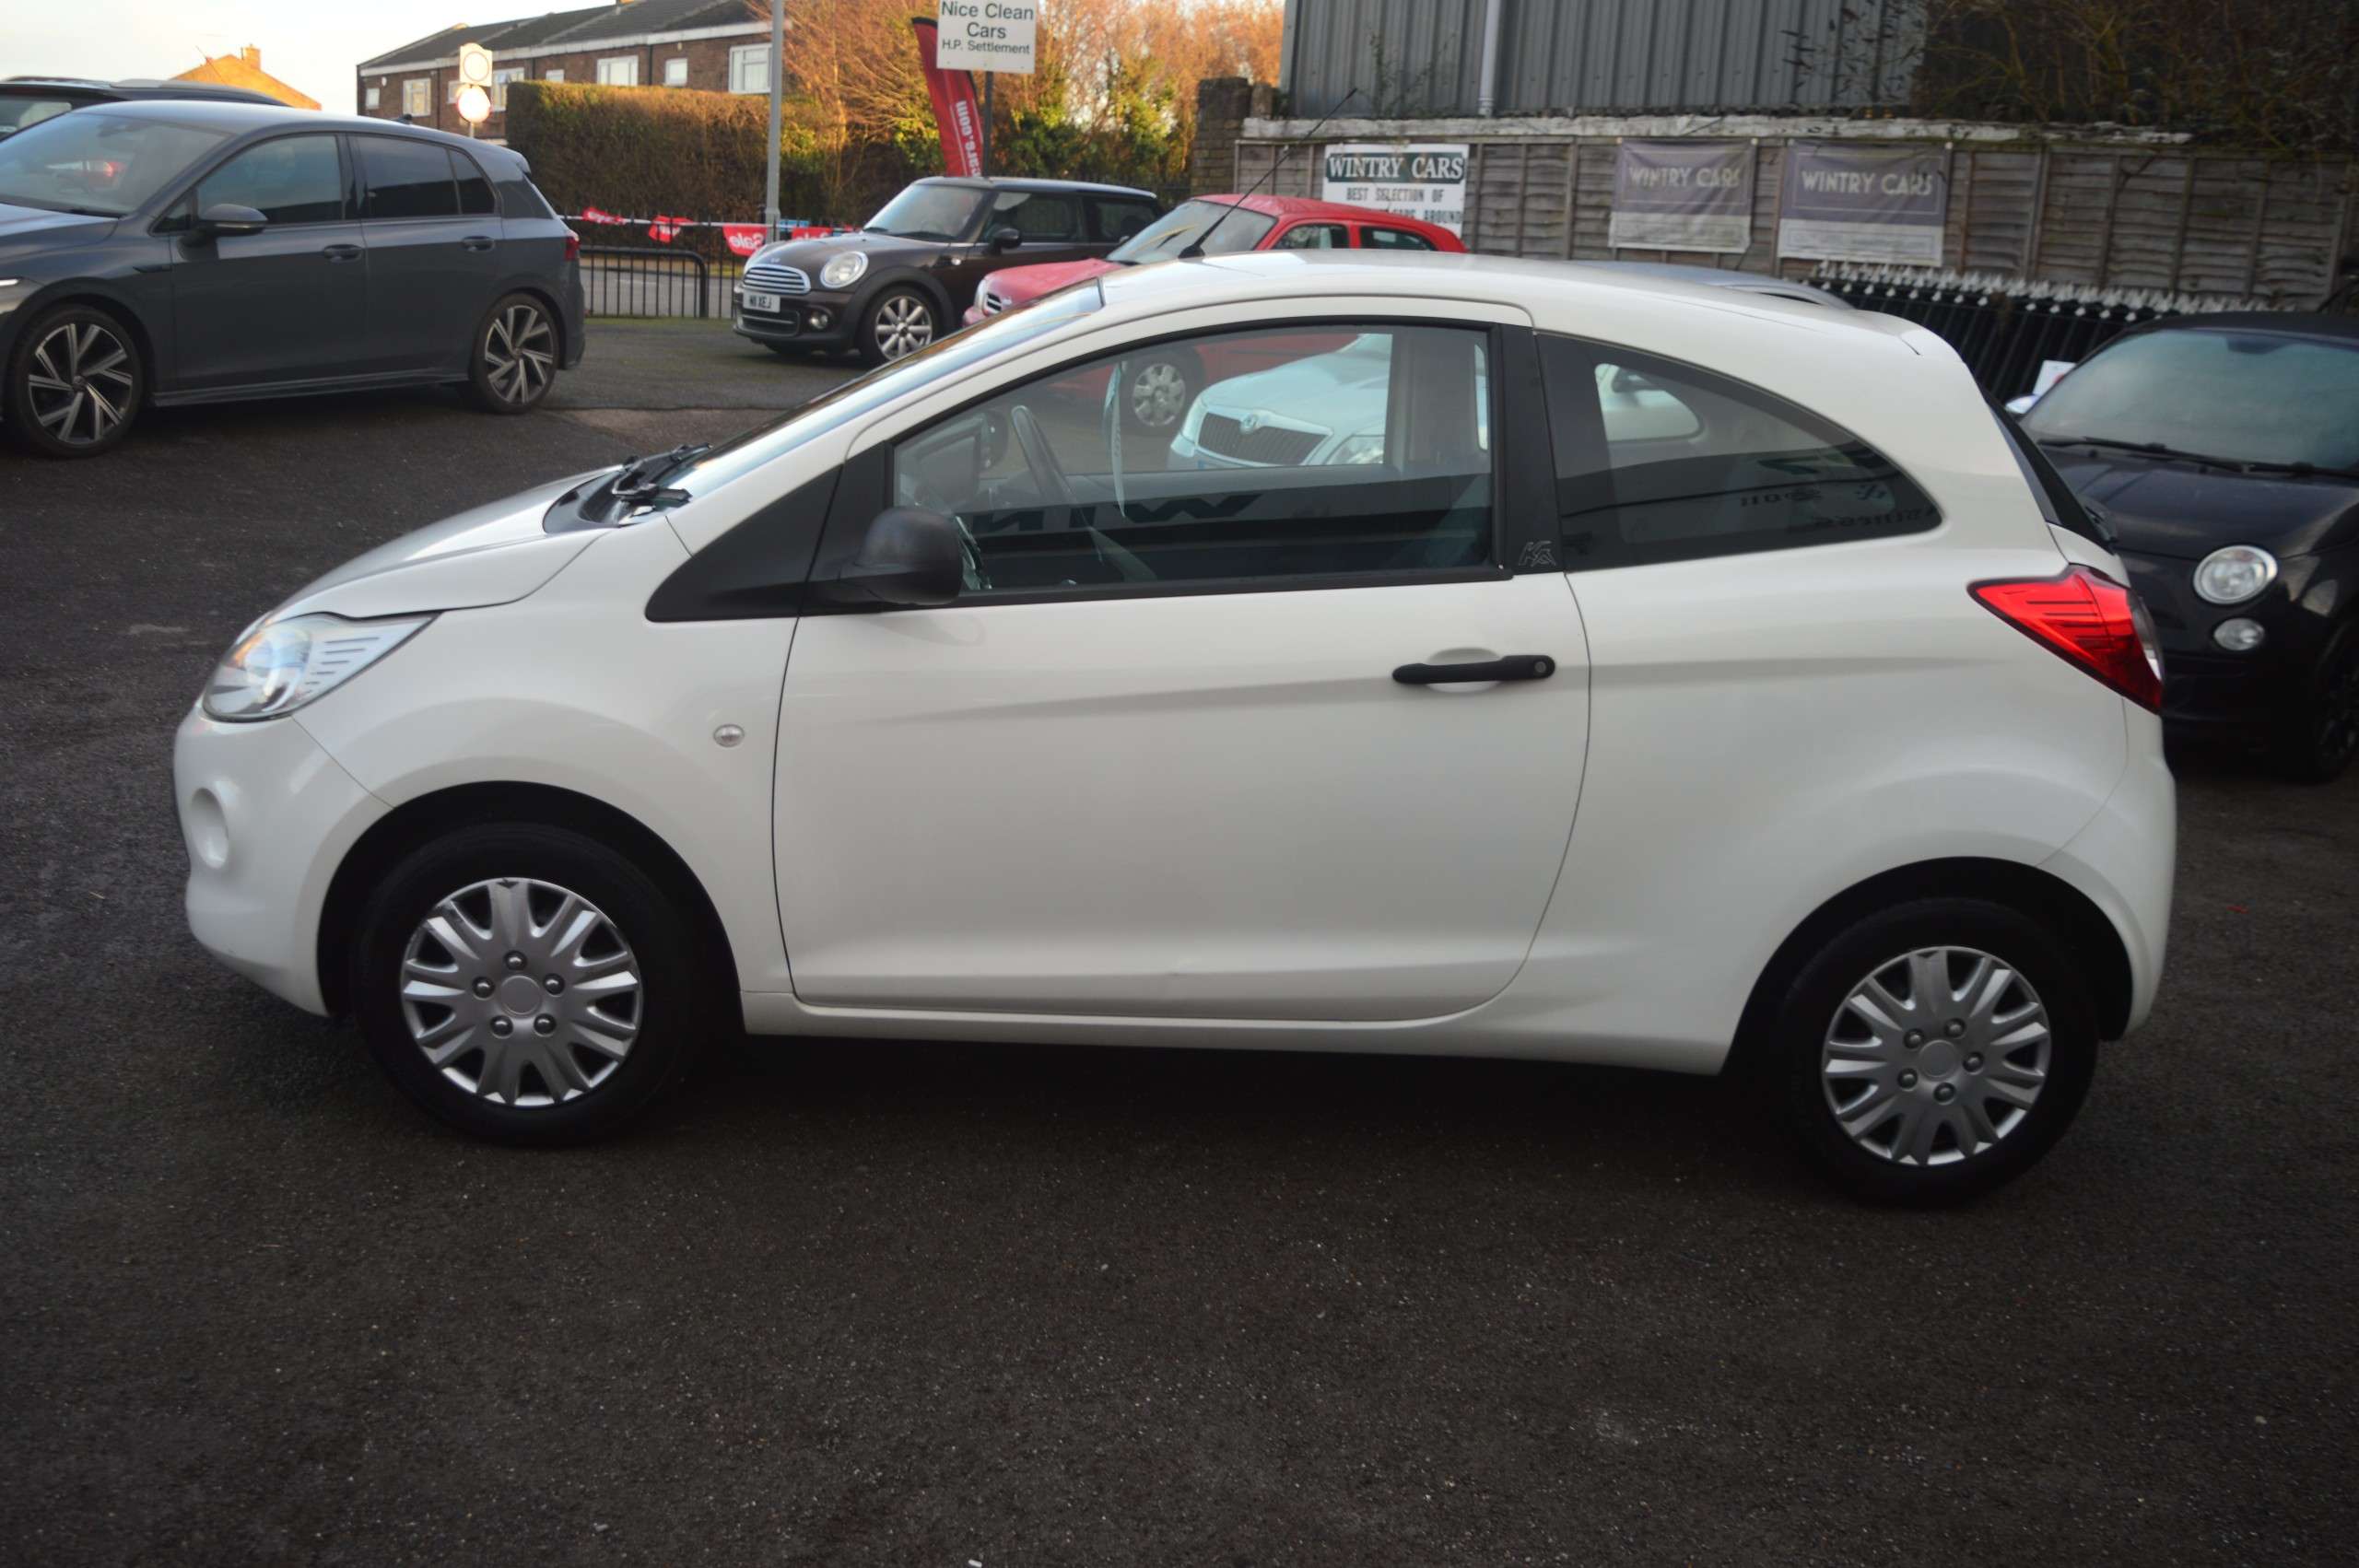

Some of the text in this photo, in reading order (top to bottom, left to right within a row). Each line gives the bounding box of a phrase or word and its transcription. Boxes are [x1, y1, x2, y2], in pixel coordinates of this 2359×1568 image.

[941, 1, 1034, 20] Nice Clean
[967, 21, 1007, 40] Cars
[942, 39, 1030, 54] H.P. Settlement
[1329, 156, 1464, 180] WINTRY CARS
[1628, 166, 1742, 190] WINTRY CARS
[1801, 170, 1932, 197] WINTRY CARS
[1346, 187, 1444, 203] BEST SELECTION OF
